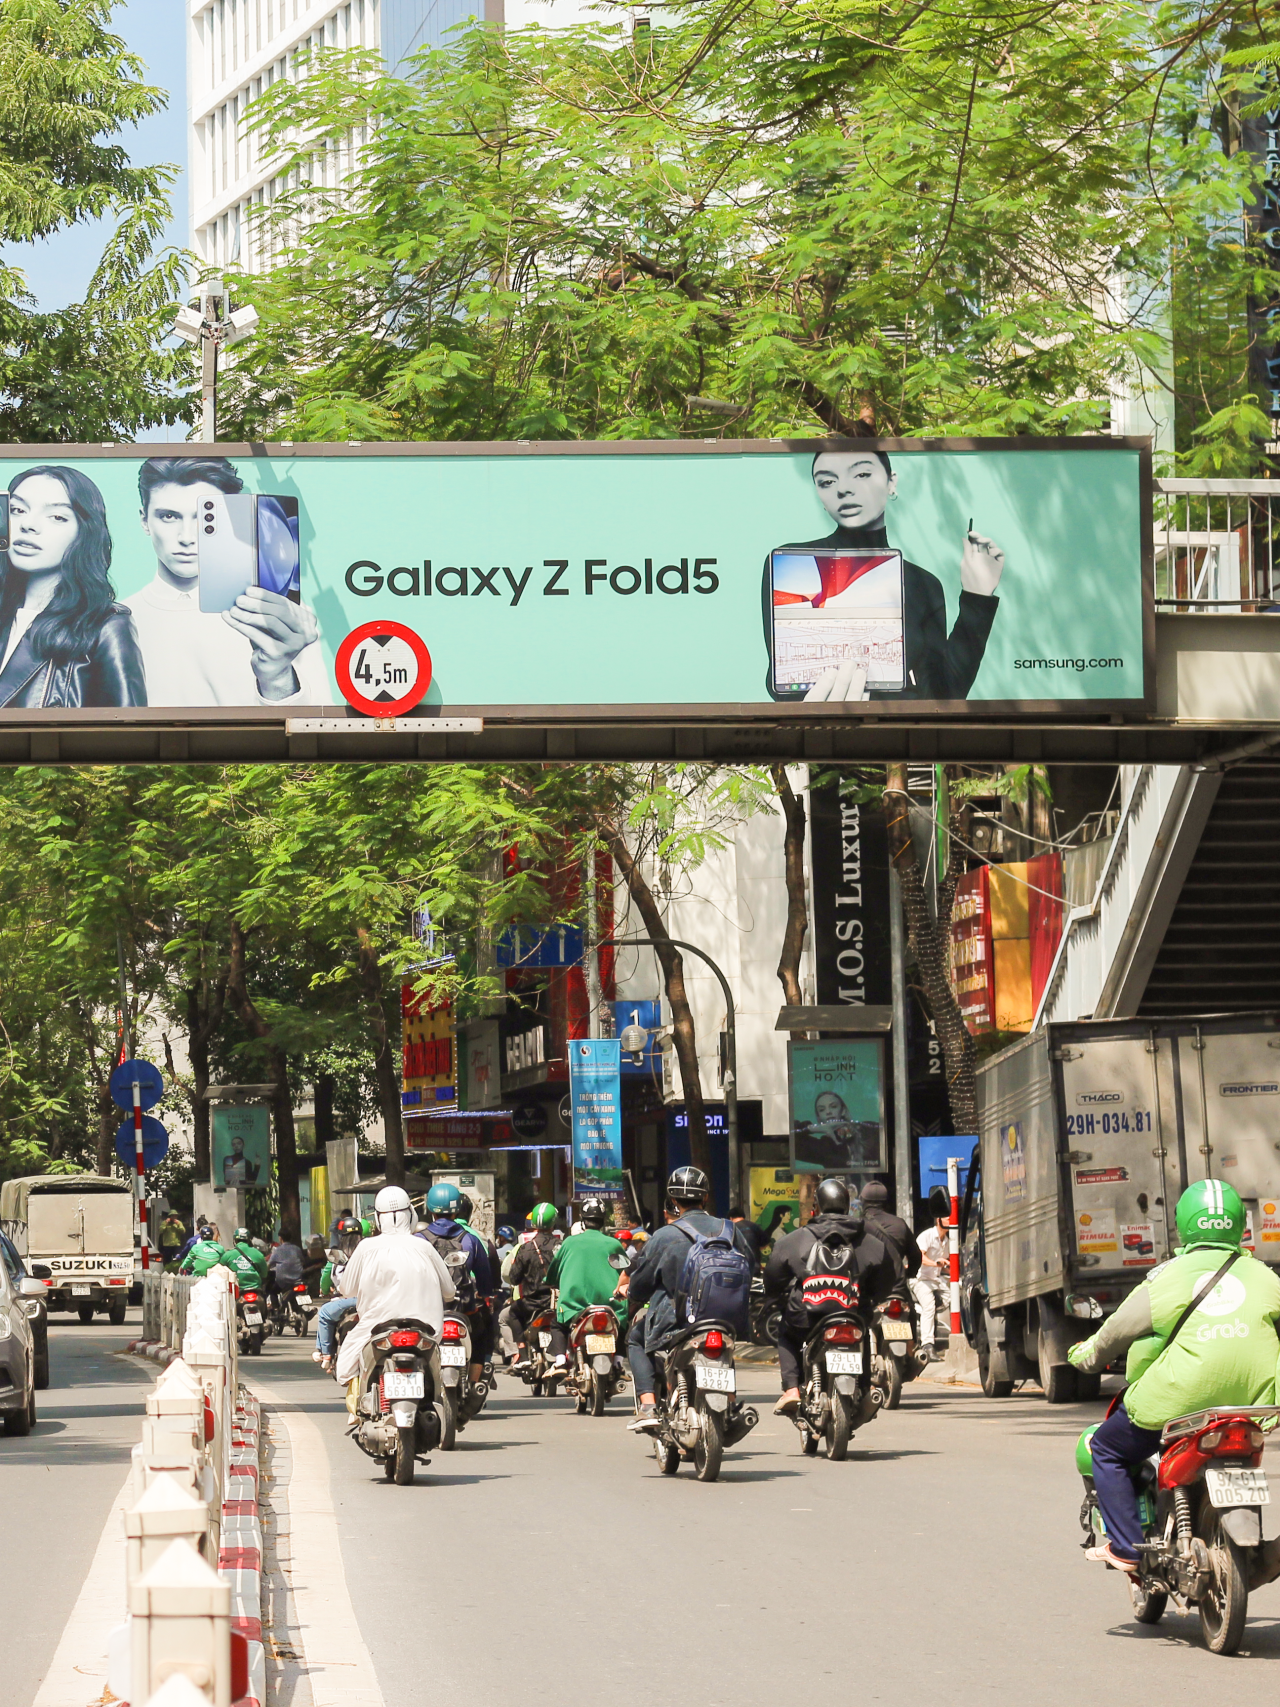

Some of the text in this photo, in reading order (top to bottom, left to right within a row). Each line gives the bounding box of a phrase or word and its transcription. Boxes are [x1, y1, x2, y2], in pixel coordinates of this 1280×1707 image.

[344, 557, 720, 607] Galaxy Z Fold5
[354, 648, 408, 688] 4,5m
[1013, 655, 1124, 672] samsung.com
[1222, 1083, 1279, 1095] FRONTIER
[1067, 1111, 1152, 1136] 29H-034.81
[1197, 1216, 1233, 1230] Grab
[1079, 1232, 1116, 1241] RIMULA
[50, 1260, 112, 1270] SUZUKI
[1197, 1318, 1250, 1342] Grab
[702, 1367, 729, 1379] 16-P7
[829, 1362, 861, 1373] 774.59
[702, 1378, 729, 1390] 3287
[1214, 1487, 1267, 1504] 005.20
